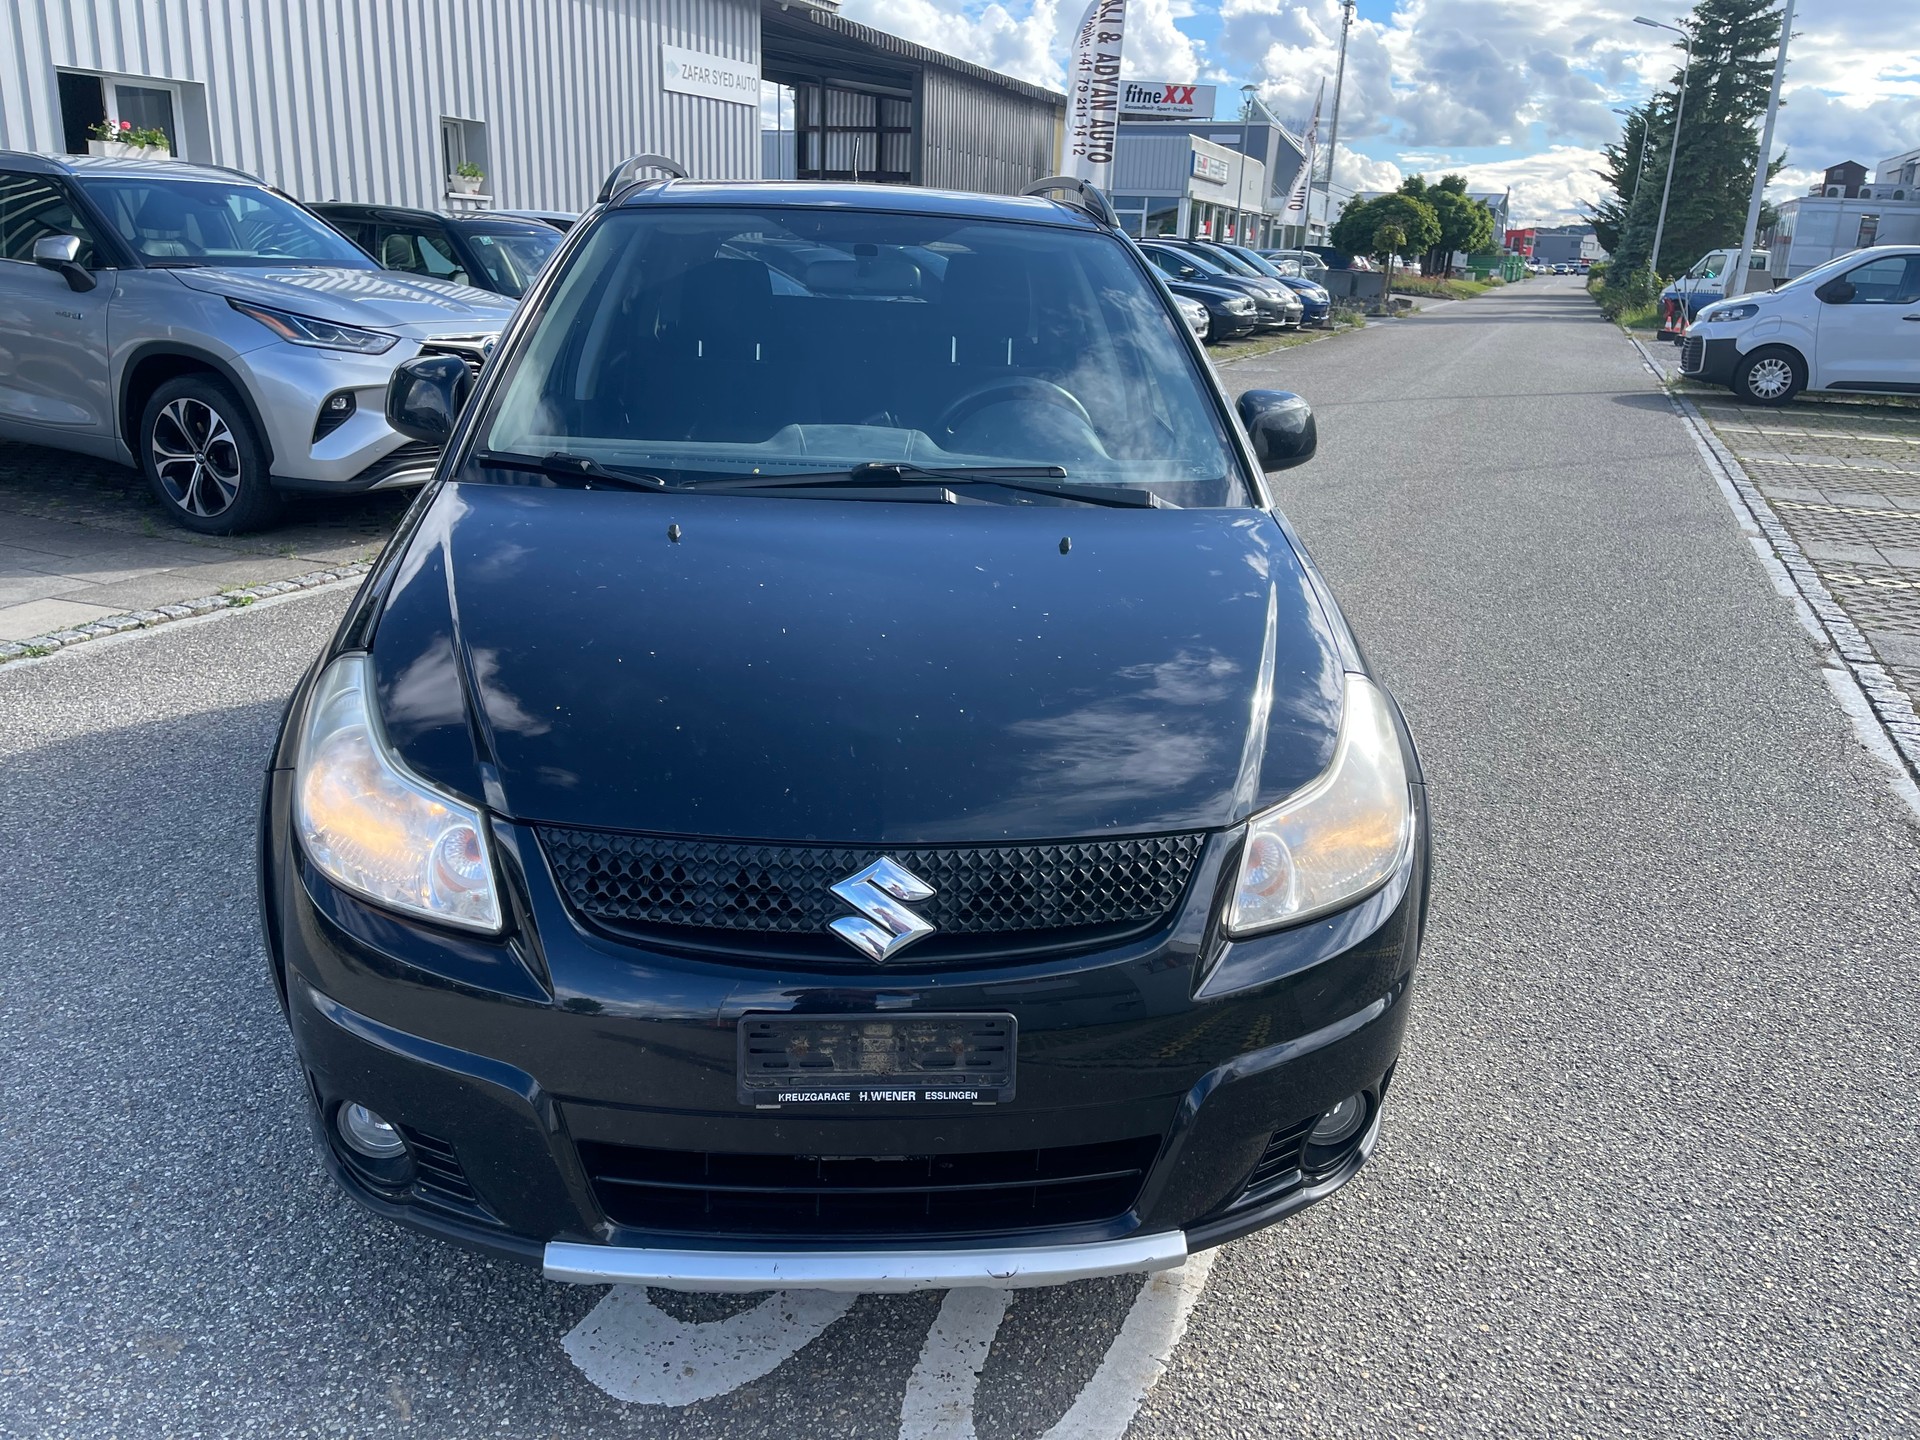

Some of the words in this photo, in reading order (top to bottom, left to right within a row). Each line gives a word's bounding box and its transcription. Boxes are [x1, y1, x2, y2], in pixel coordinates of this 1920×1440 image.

[1098, 31, 1122, 44] &
[1079, 52, 1093, 71] +41
[682, 64, 710, 84] ZAFAR
[712, 70, 734, 88] SYED
[736, 74, 757, 92] AUTO
[1077, 79, 1089, 92] 79
[1090, 53, 1120, 110] ADYAN
[1125, 84, 1197, 104] fitneXX
[1076, 98, 1087, 117] 211
[1074, 125, 1087, 136] 14
[1073, 143, 1086, 155] 12
[1087, 118, 1115, 163] AUTO
[778, 1092, 851, 1102] KREUZGARAGE
[858, 1091, 916, 1102] H.WIENER
[925, 1091, 978, 1100] ESSLINGEN
